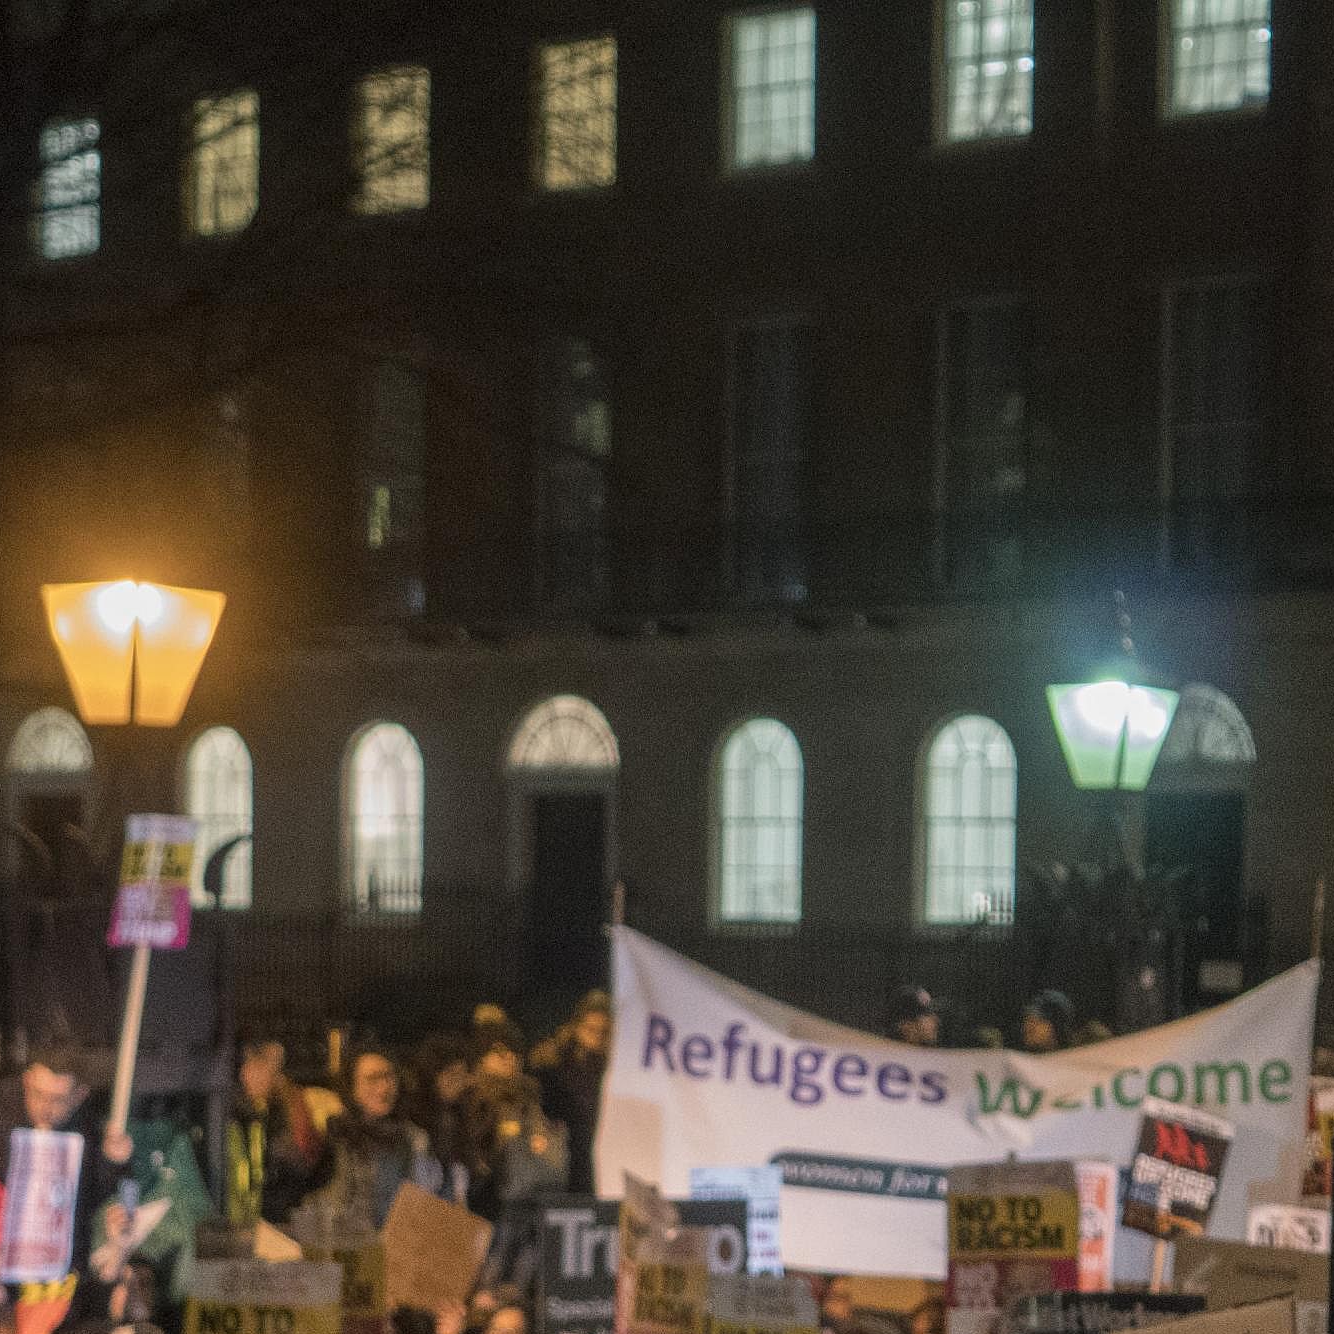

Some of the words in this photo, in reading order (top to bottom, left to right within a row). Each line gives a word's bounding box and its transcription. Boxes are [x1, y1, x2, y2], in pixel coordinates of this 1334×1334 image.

[641, 1012, 948, 1104] Refugees
[973, 1056, 1293, 1118] Wcome
[1006, 1196, 1043, 1222] TO
[197, 1305, 241, 1334] NO
